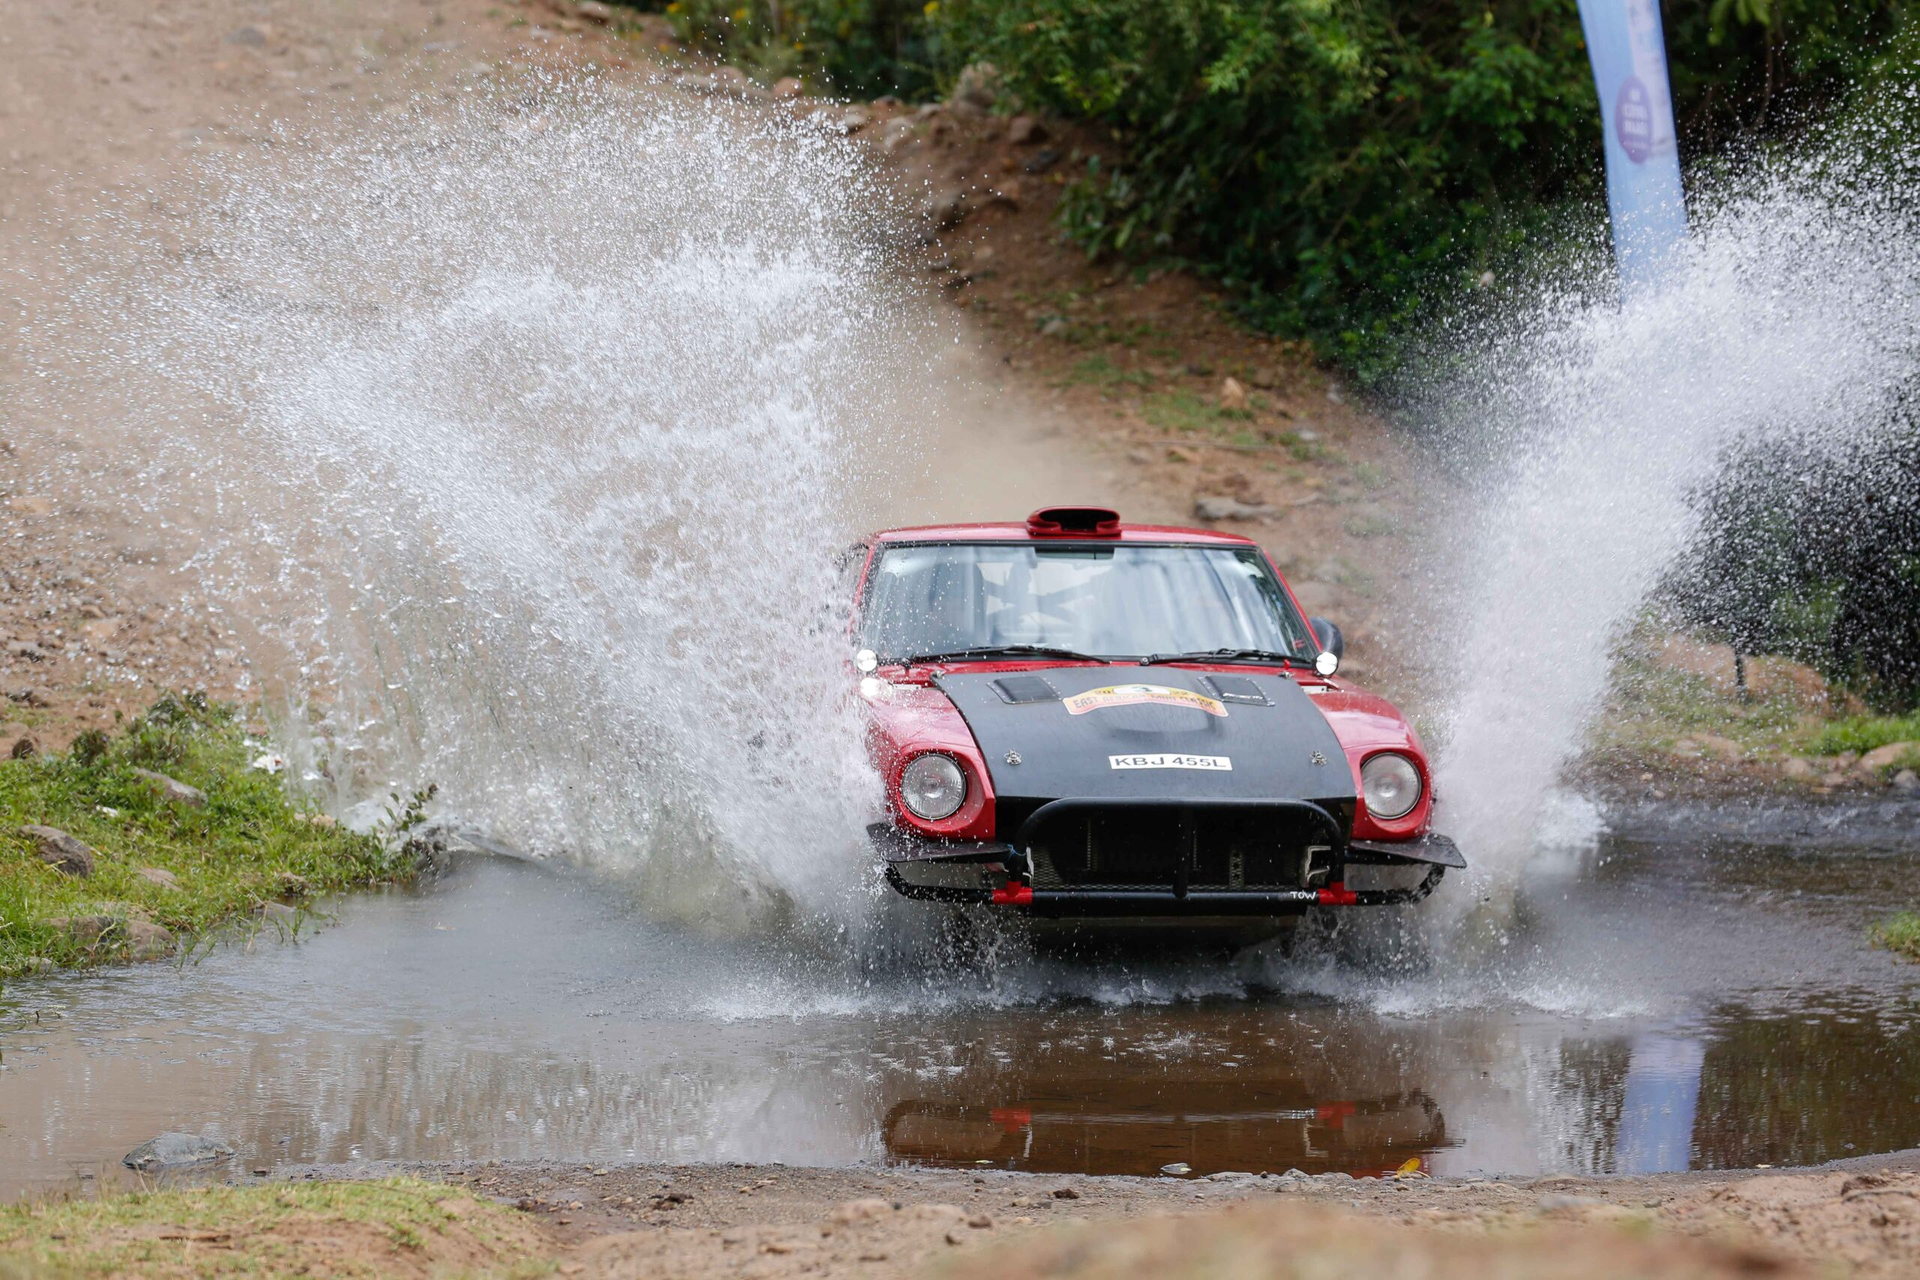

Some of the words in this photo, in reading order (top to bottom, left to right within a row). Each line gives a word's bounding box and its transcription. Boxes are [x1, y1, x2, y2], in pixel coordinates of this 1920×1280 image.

[1073, 696, 1098, 708] EAST
[1114, 757, 1165, 766] KBJ
[1172, 757, 1227, 768] 455L
[1290, 890, 1316, 900] TOW
